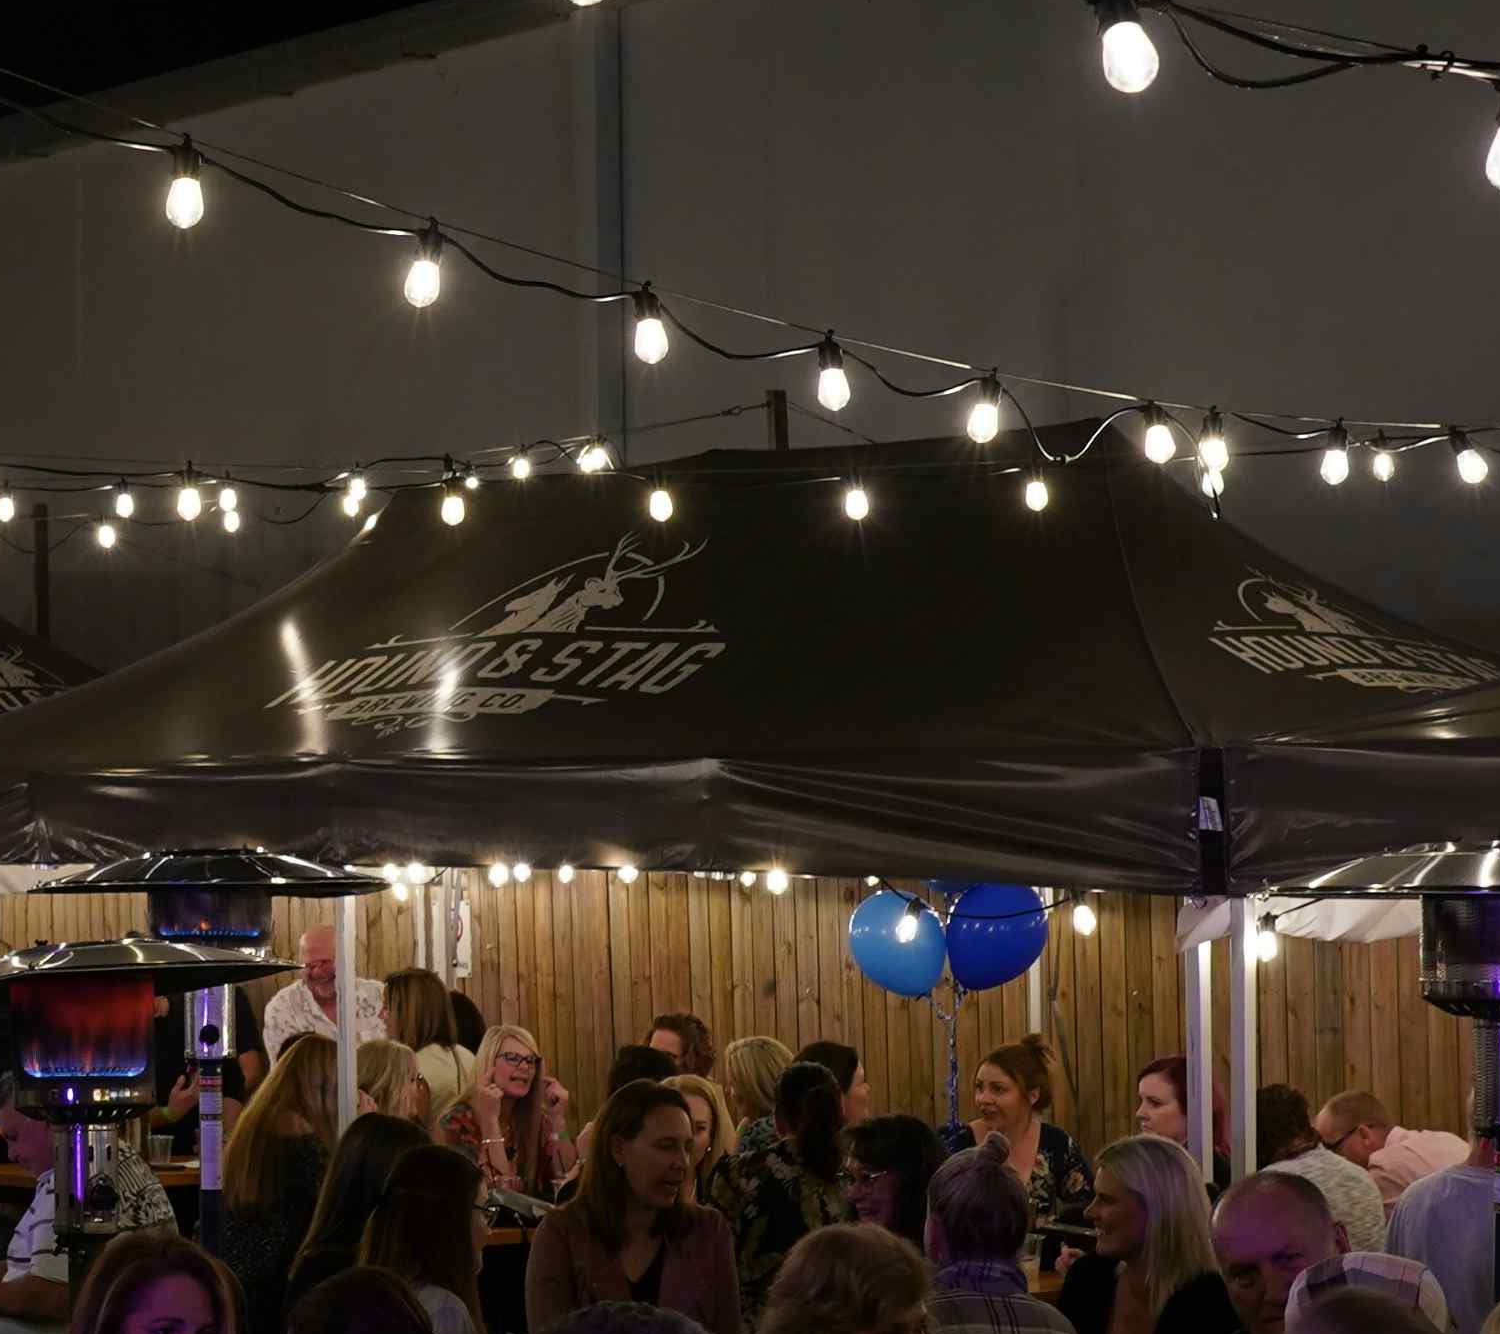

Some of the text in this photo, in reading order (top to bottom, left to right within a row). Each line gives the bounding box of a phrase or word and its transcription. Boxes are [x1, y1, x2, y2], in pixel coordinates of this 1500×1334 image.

[477, 637, 543, 679] &
[530, 640, 729, 695] STAG
[1208, 635, 1383, 674] HOUND
[347, 692, 525, 717] BREWG CO.
